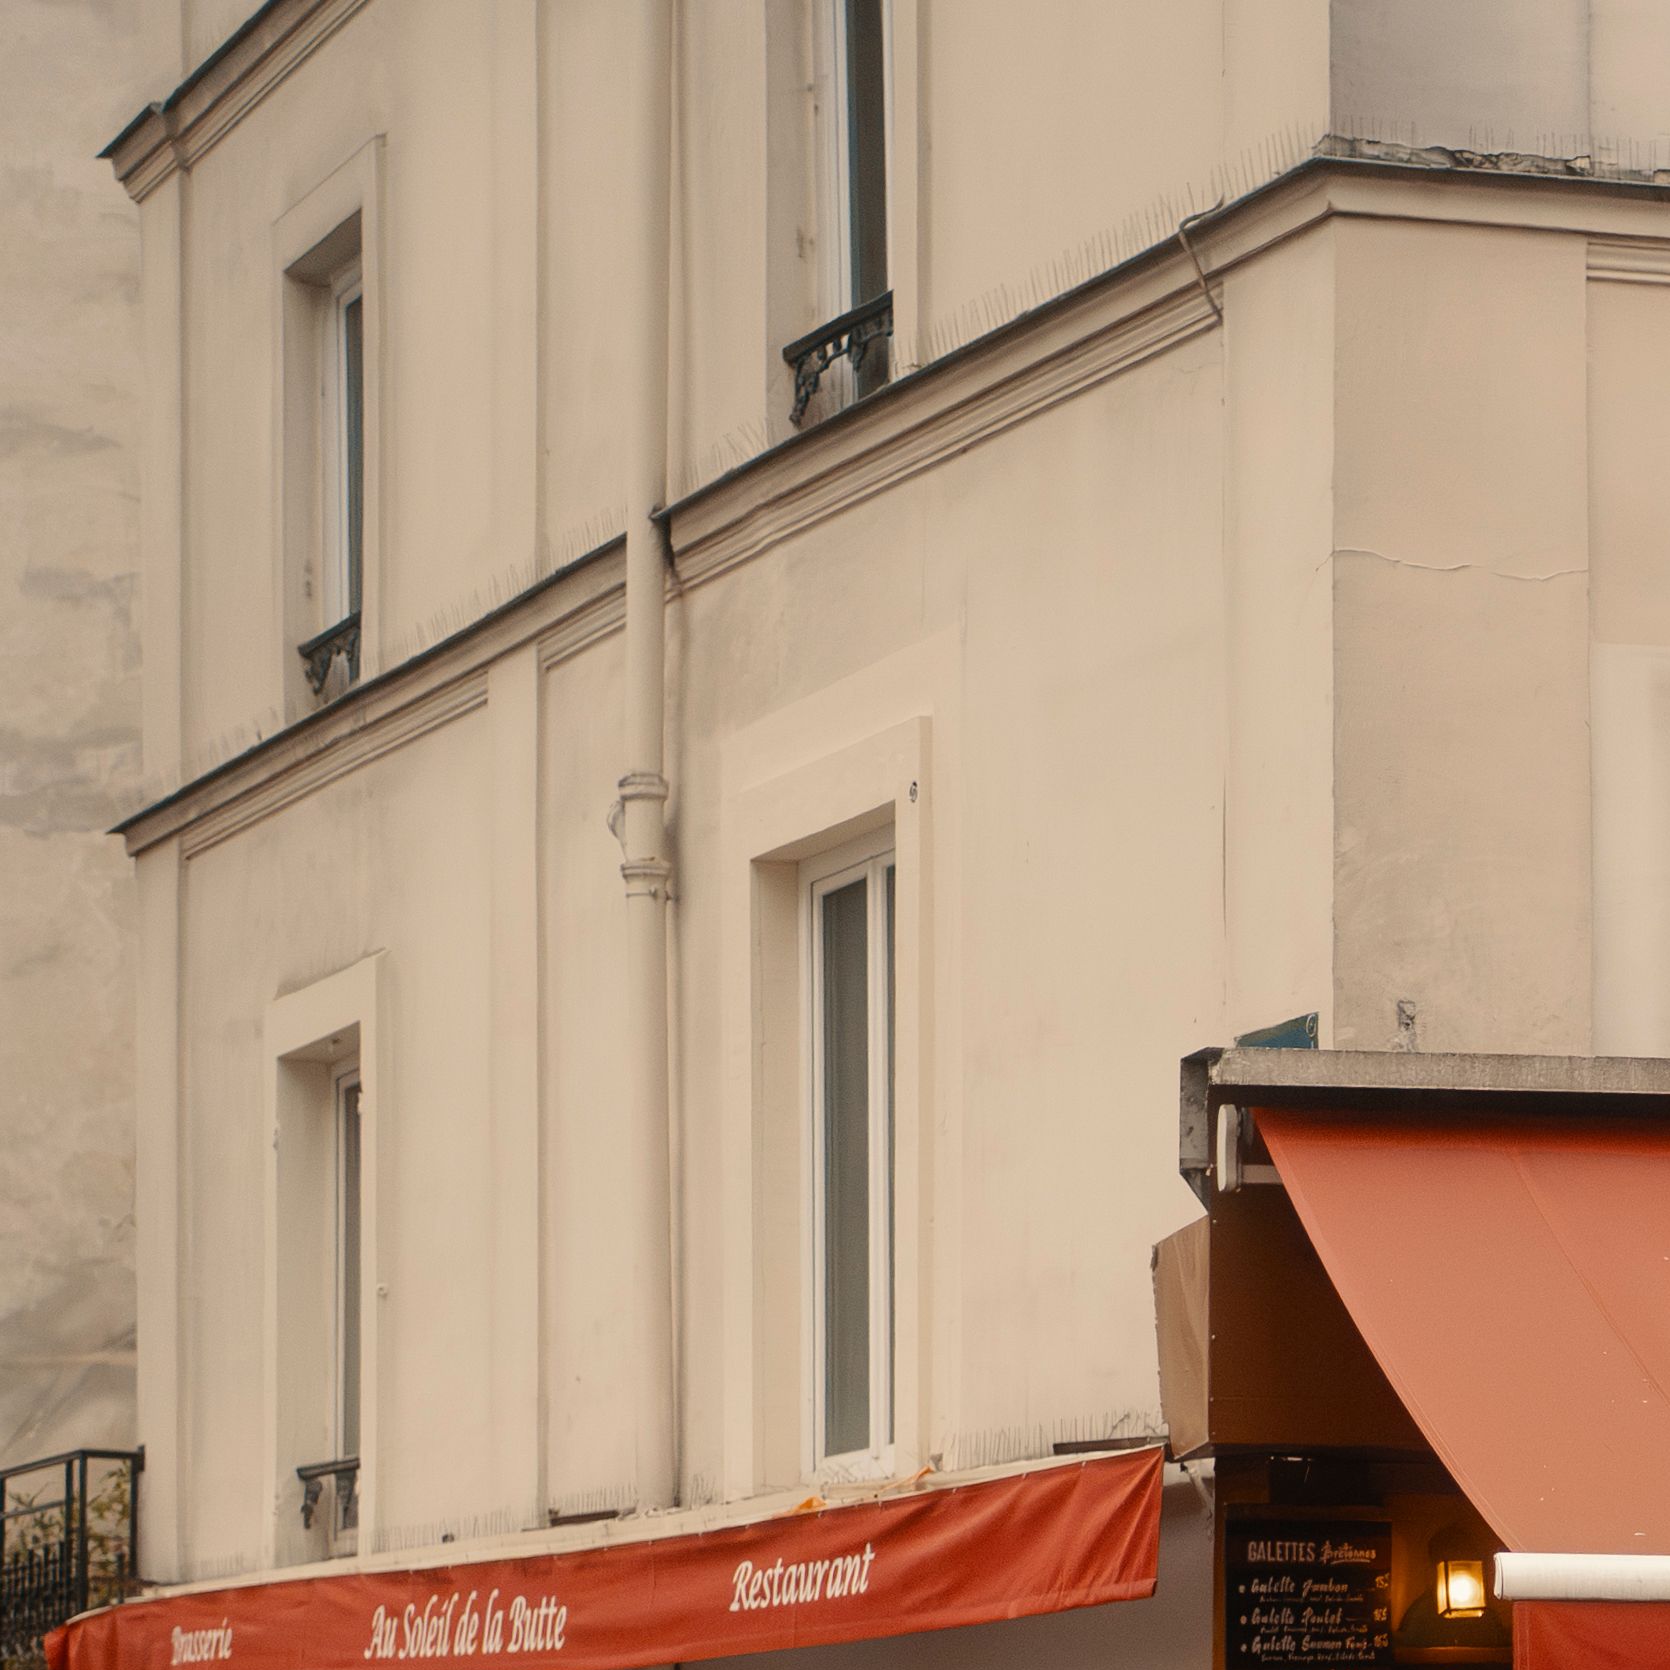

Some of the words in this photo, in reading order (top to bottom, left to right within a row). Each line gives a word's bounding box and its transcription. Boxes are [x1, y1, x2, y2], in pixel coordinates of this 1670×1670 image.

[728, 1542, 877, 1614] Restaurant
[1247, 1540, 1317, 1563] GALETTES
[364, 1604, 399, 1660] Au
[398, 1591, 460, 1660] Soleil
[453, 1589, 480, 1657] de
[481, 1587, 504, 1656] la
[506, 1594, 568, 1654] Butte
